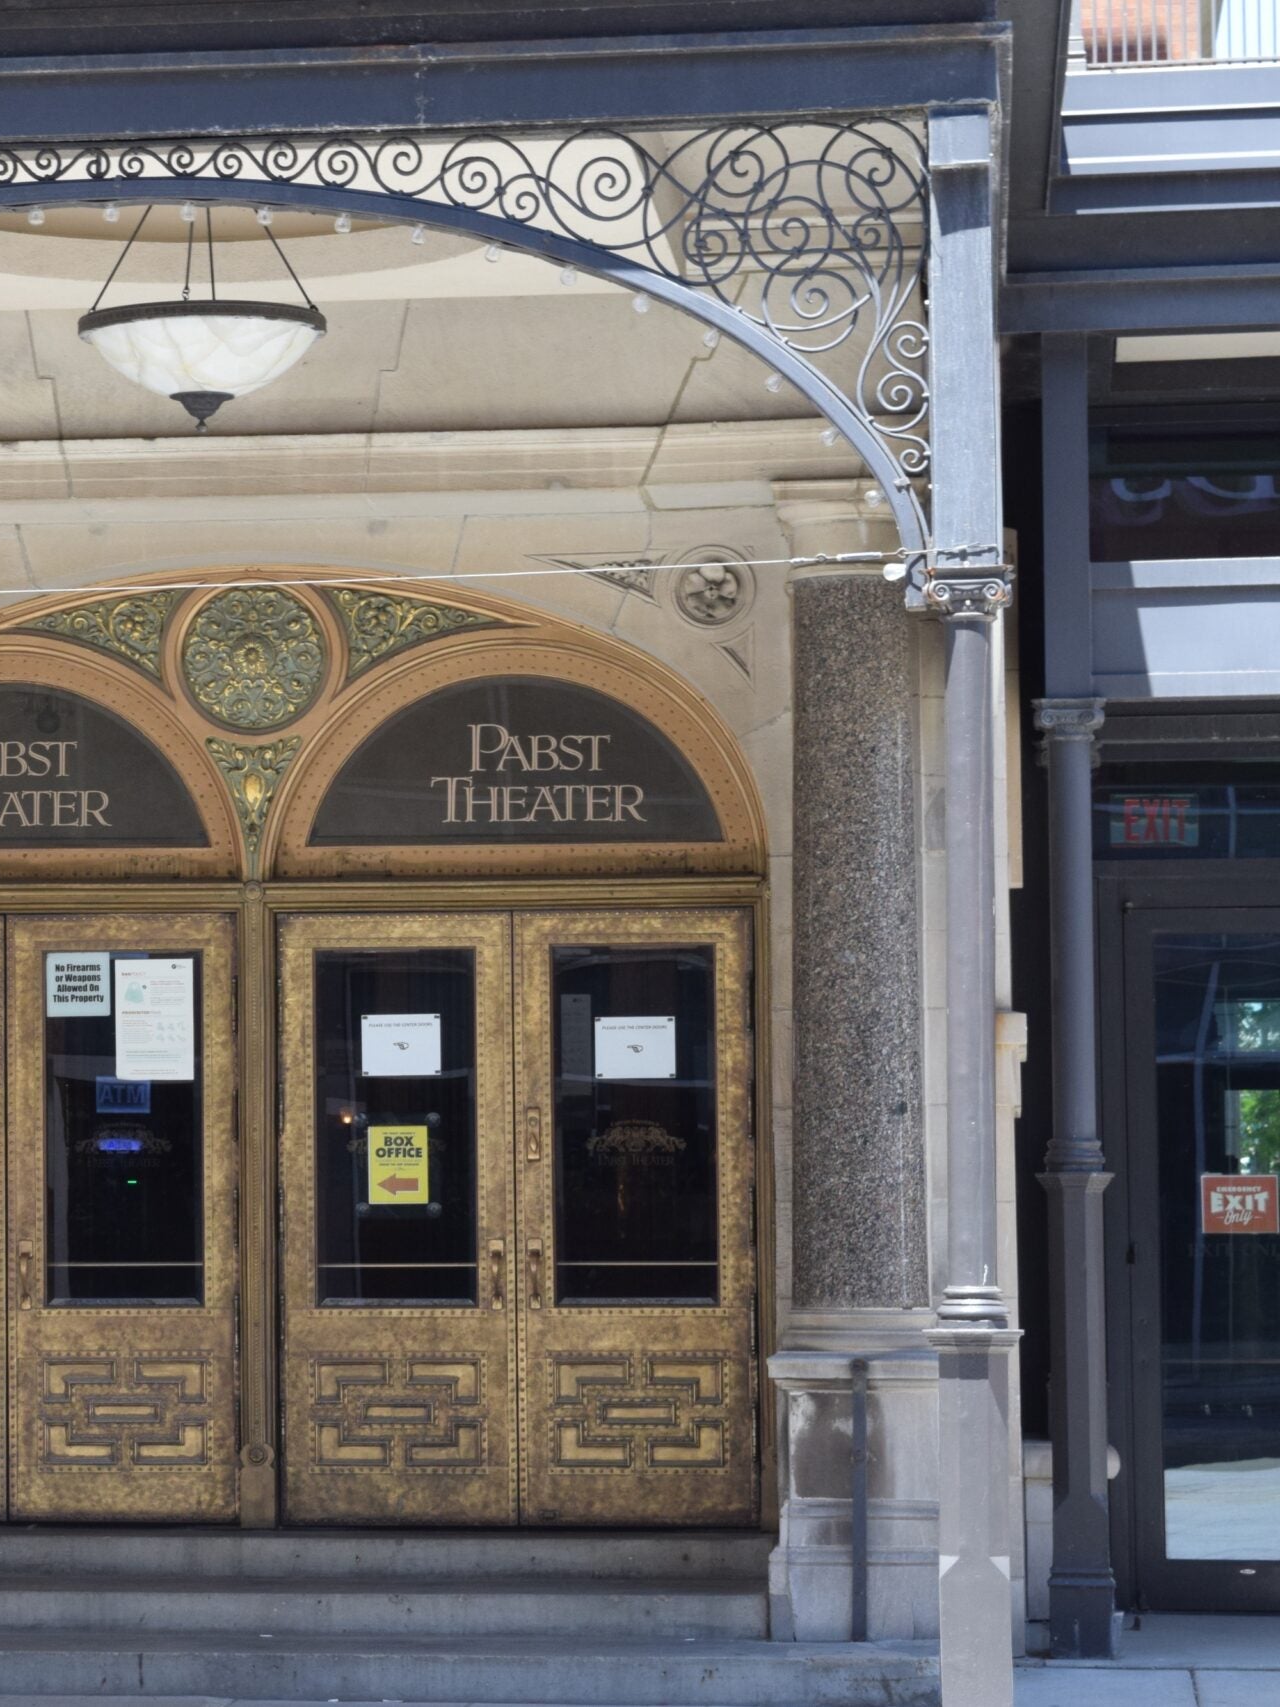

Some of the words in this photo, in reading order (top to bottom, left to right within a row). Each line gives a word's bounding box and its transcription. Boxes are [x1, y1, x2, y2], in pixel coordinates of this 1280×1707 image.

[467, 723, 612, 772] PABST
[430, 776, 648, 823] THEATER
[1124, 799, 1191, 842] EXIT
[55, 964, 65, 972] No
[66, 963, 101, 972] Firearms
[65, 974, 101, 982] Weapons
[57, 984, 88, 992] Allowed
[89, 984, 100, 992] On
[53, 994, 69, 1003] This
[70, 994, 104, 1003] Property
[100, 1085, 145, 1103] ATM
[384, 1136, 414, 1147] BOX
[375, 1147, 423, 1158] OFFICE
[1216, 1185, 1262, 1193] EMERGENCY
[1210, 1191, 1269, 1214] EXIT
[1223, 1208, 1253, 1226] Only
